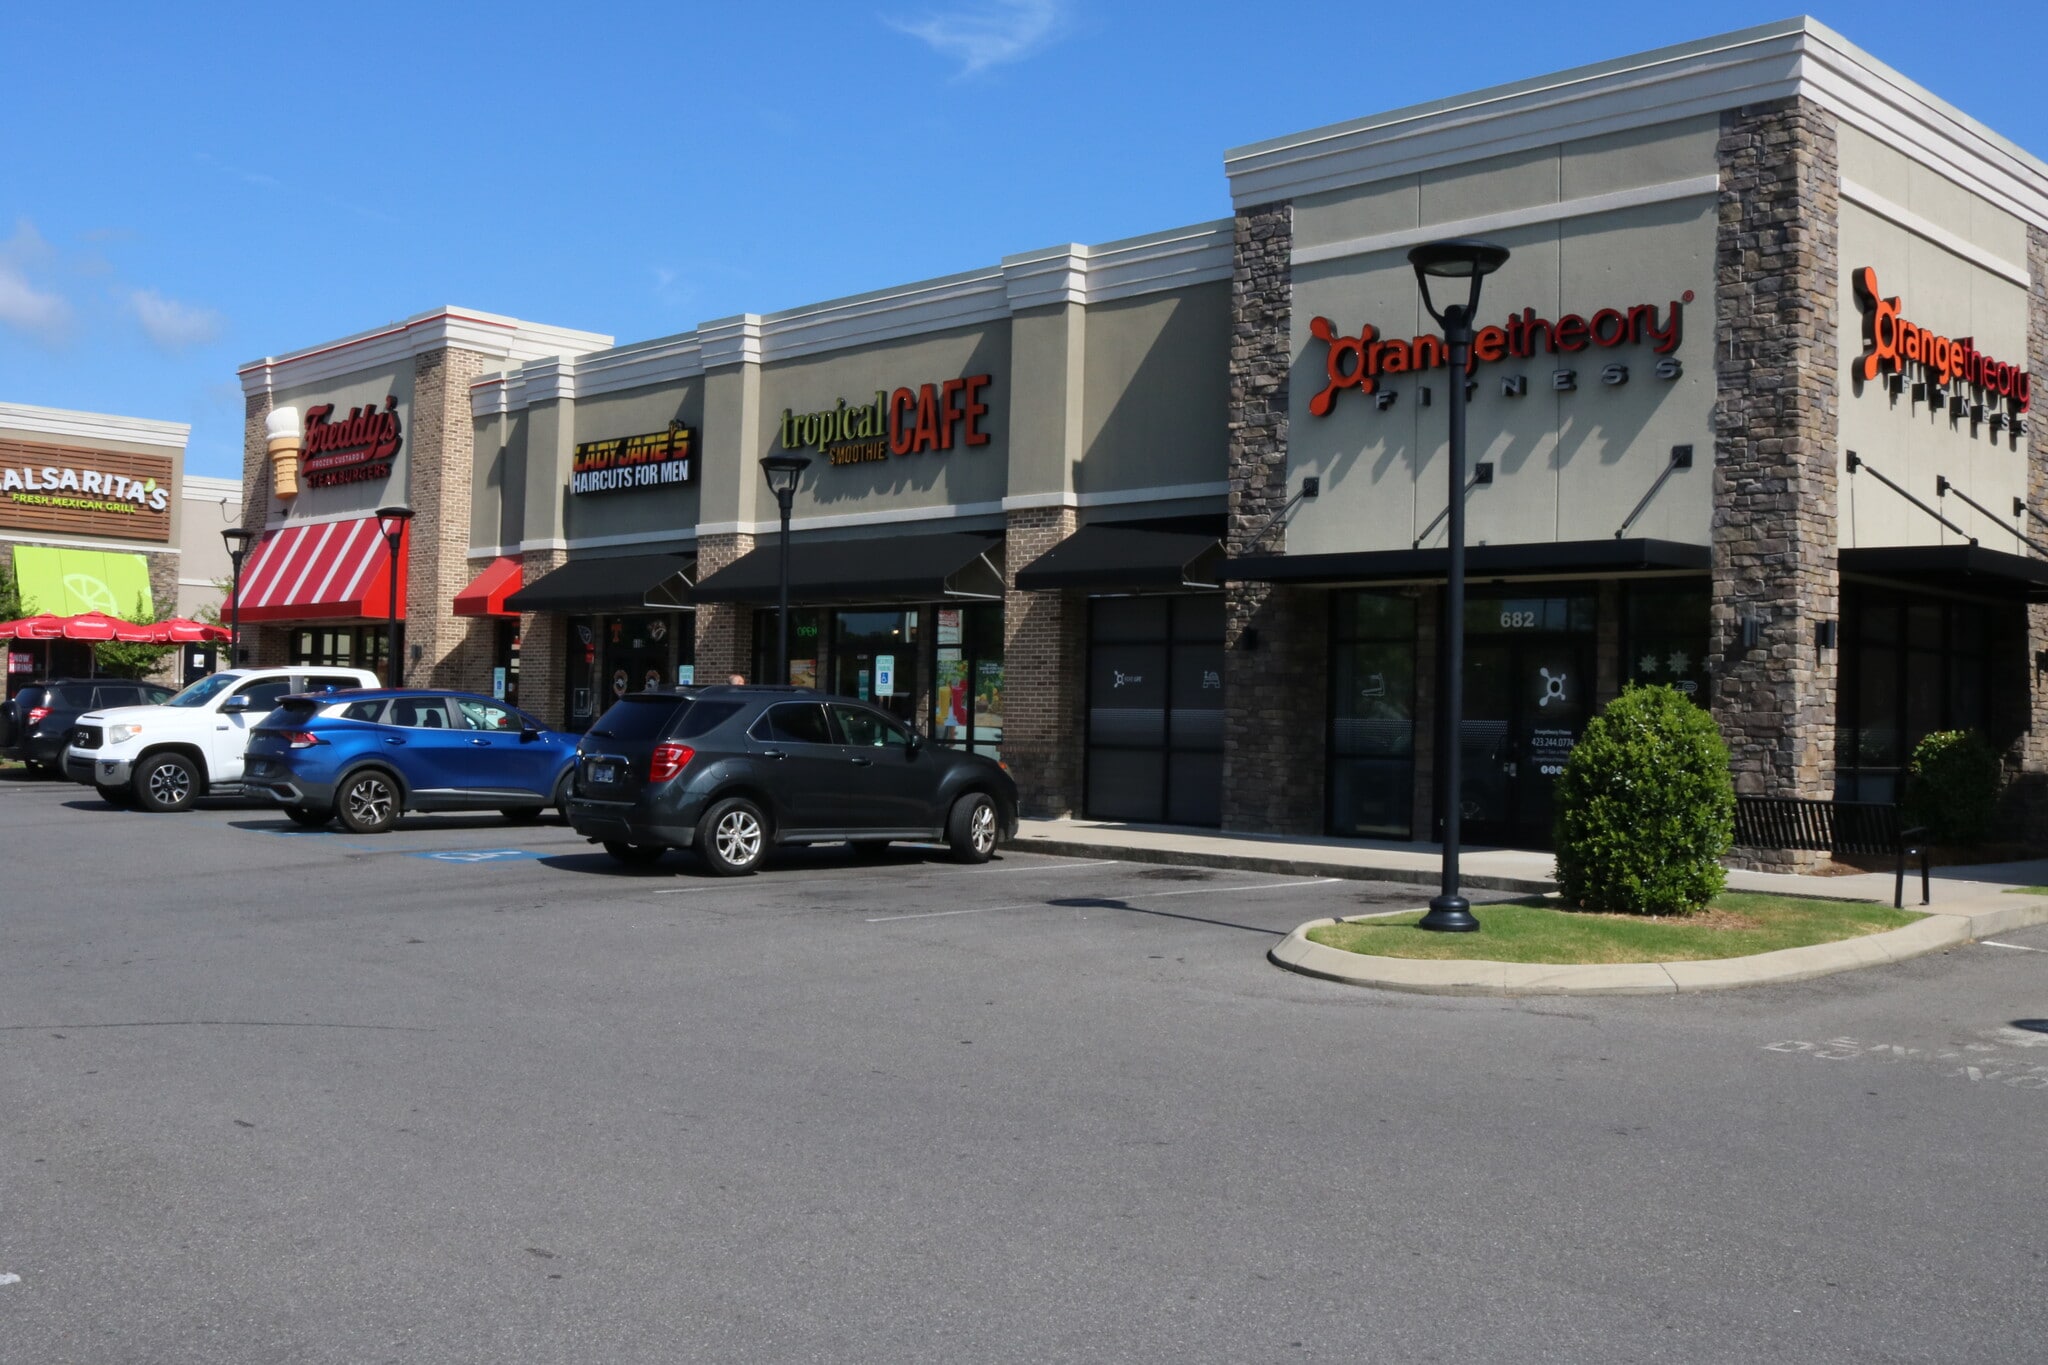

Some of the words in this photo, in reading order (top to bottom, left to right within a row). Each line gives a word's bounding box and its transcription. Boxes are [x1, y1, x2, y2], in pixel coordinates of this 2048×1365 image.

[781, 390, 888, 452] tropical
[890, 374, 990, 455] CAFE
[1902, 375, 2029, 437] FITNESS
[300, 395, 398, 460] Freddy's
[312, 458, 334, 468] FROZEN
[335, 453, 360, 465] CUSTARD
[573, 440, 621, 472] LADY
[829, 441, 886, 465] SMOOTHIE
[307, 464, 389, 488] STEAKBURGERS
[572, 467, 632, 494] HAIRCUTS
[635, 464, 658, 486] FOR
[661, 460, 688, 483] MEN
[0, 467, 169, 510] ALSARITA'S
[13, 493, 49, 504] FRESH
[52, 497, 103, 510] MEXICAN
[106, 502, 136, 513] GRILL
[797, 626, 817, 637] OPEN
[1500, 611, 1534, 628] 682
[12, 653, 30, 663] NOW
